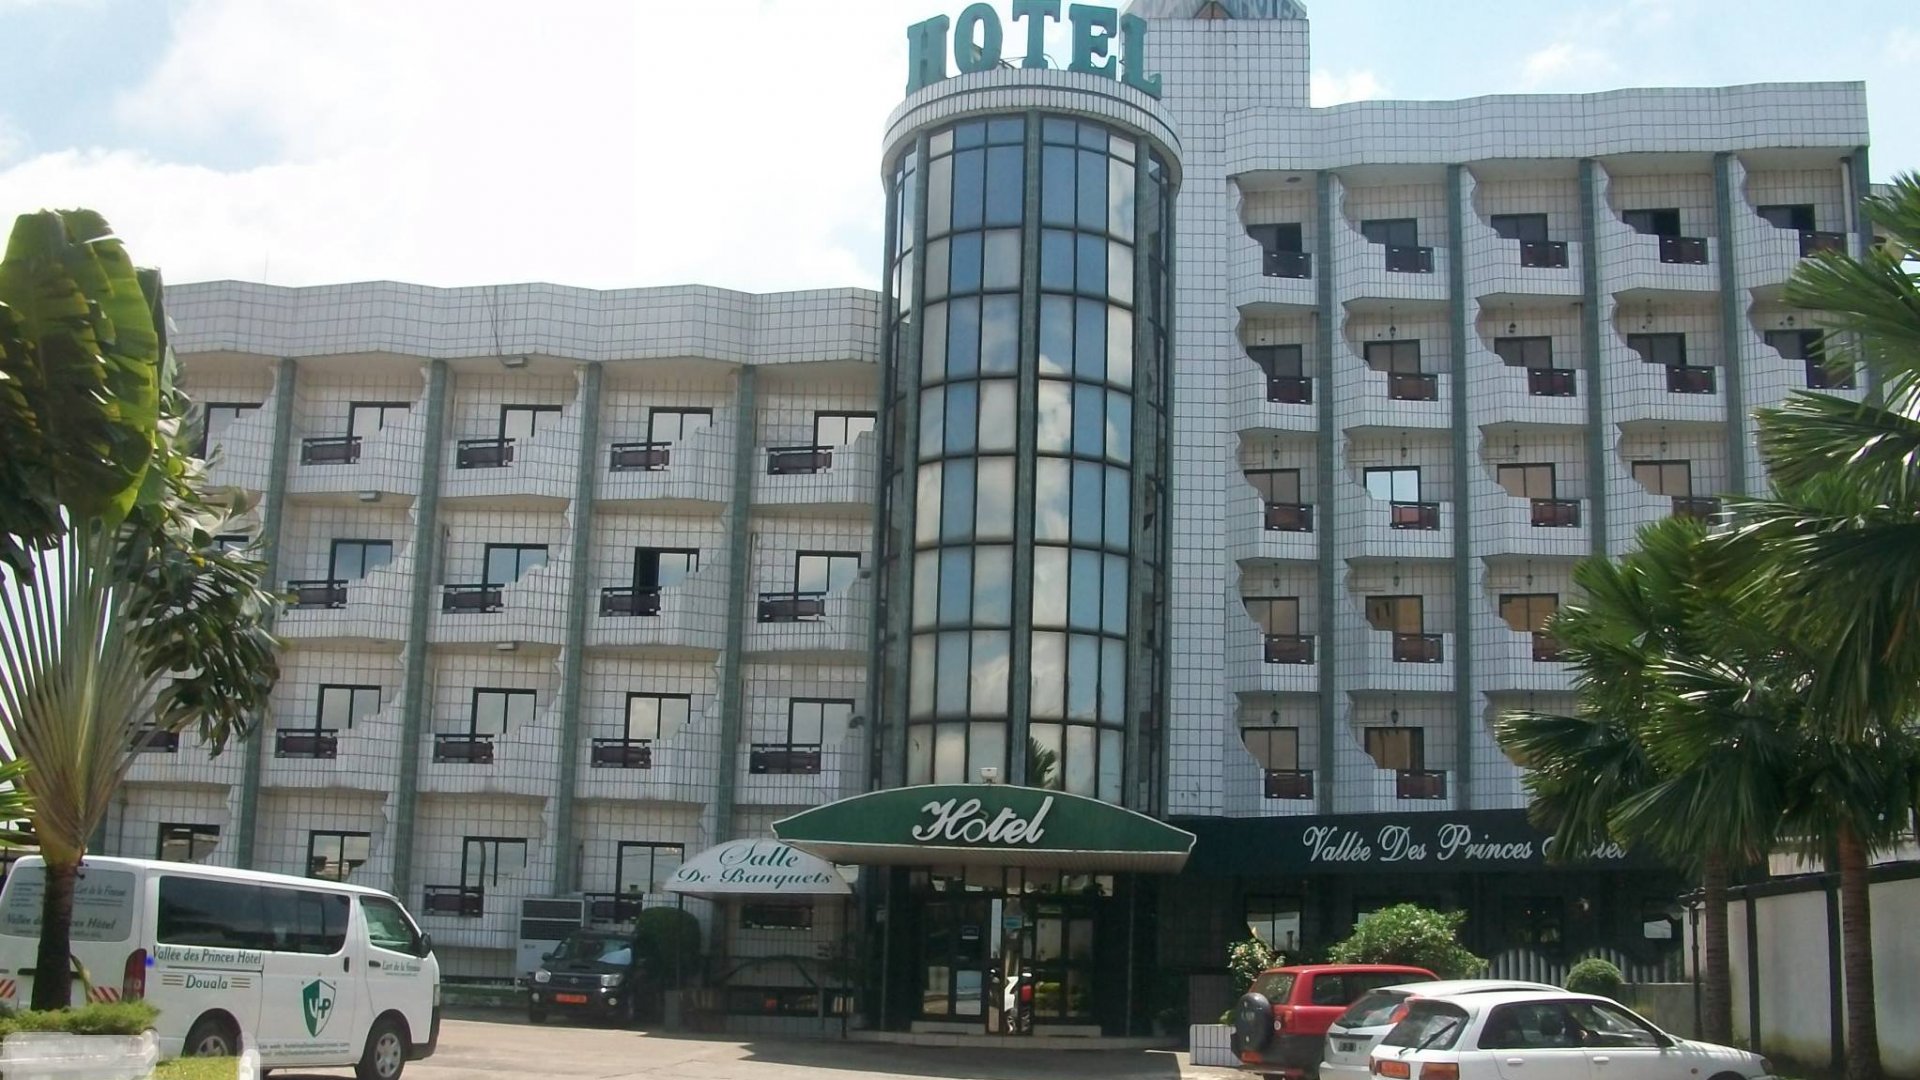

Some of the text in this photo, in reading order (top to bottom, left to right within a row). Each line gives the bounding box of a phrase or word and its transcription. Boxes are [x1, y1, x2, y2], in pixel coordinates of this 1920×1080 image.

[906, 0, 1162, 100] HOTEL
[719, 840, 799, 868] Salle
[1302, 825, 1371, 862] Vallée
[1377, 824, 1427, 862] Des
[1437, 823, 1532, 861] Princes
[677, 868, 832, 889] De Banquets
[153, 945, 262, 964] Vallée des Princes Hôtel
[185, 974, 228, 989] Douala
